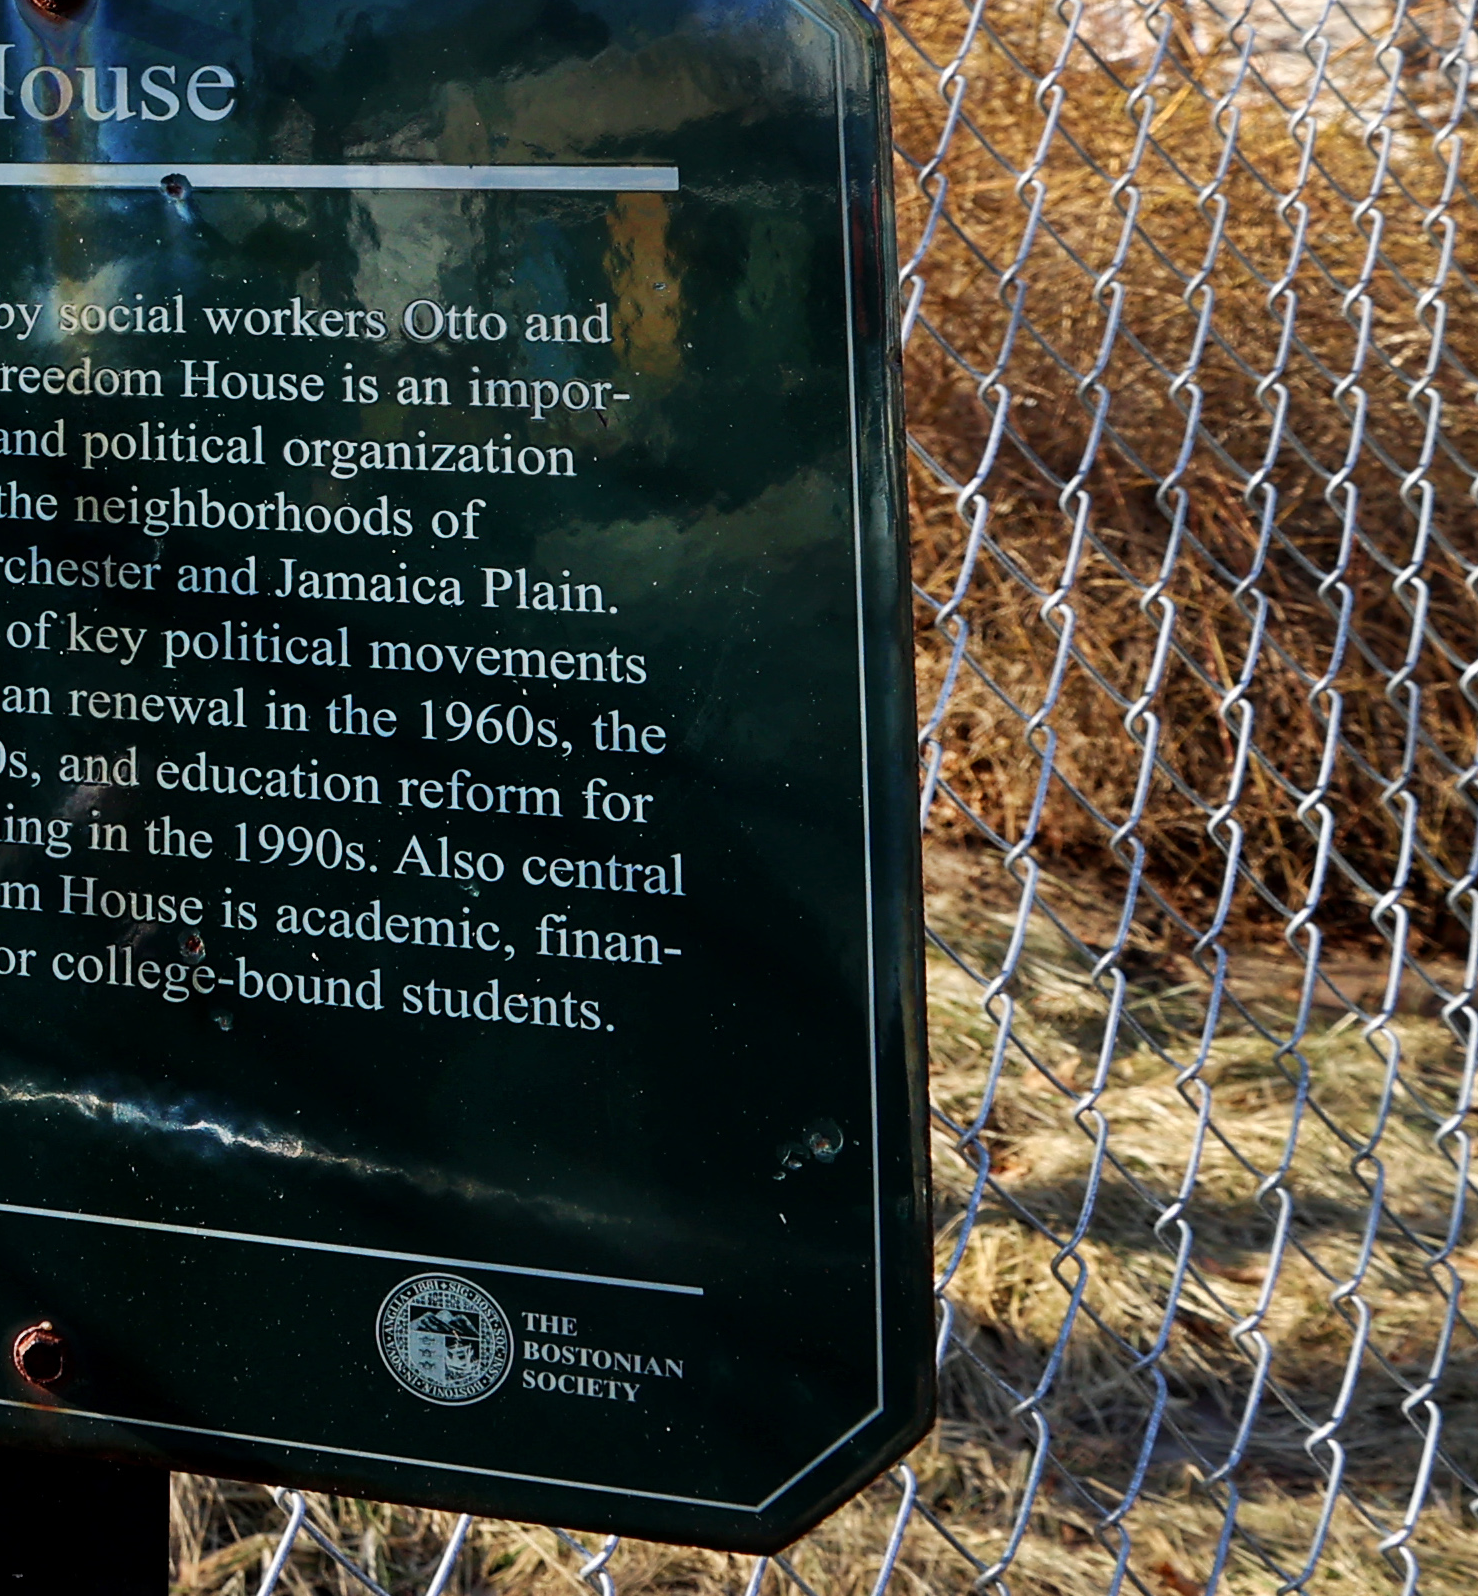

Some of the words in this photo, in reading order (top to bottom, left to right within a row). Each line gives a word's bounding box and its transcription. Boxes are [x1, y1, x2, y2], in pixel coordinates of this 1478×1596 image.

[58, 292, 188, 335] social
[201, 295, 390, 340] workers
[402, 298, 509, 344] Otto
[524, 301, 613, 344] and
[179, 359, 325, 403] House
[341, 362, 379, 405] is
[396, 376, 453, 407] an
[468, 365, 631, 423] impor-
[81, 420, 267, 470] political
[282, 429, 578, 480] organization
[74, 484, 414, 538] neighborhoods
[431, 498, 486, 540] of
[177, 555, 260, 596] and
[274, 557, 466, 607] Jamaica
[480, 567, 618, 615] Plain.
[6, 609, 58, 650] of
[66, 611, 148, 666] key
[160, 619, 352, 669] political
[368, 640, 647, 685] movements
[67, 686, 248, 728] renewal
[264, 688, 310, 732] in
[325, 693, 398, 738] the
[420, 699, 573, 758] 1960s,
[590, 709, 667, 755] the
[58, 745, 141, 788] and
[156, 750, 383, 805] education
[397, 768, 564, 818] reform
[581, 777, 654, 824] for
[87, 809, 131, 853] in
[144, 814, 214, 860] the
[234, 821, 378, 873] 1990s.
[392, 834, 505, 883] Also
[521, 852, 687, 897] central
[58, 874, 204, 926] House
[220, 886, 258, 931] is
[275, 899, 516, 962] academic,
[535, 913, 682, 966] finan-
[51, 944, 385, 1012] college-bound
[402, 978, 615, 1033] students.
[521, 1312, 578, 1337] THE
[521, 1368, 641, 1403] SOCIETY
[522, 1341, 685, 1380] BOSTONIAN
